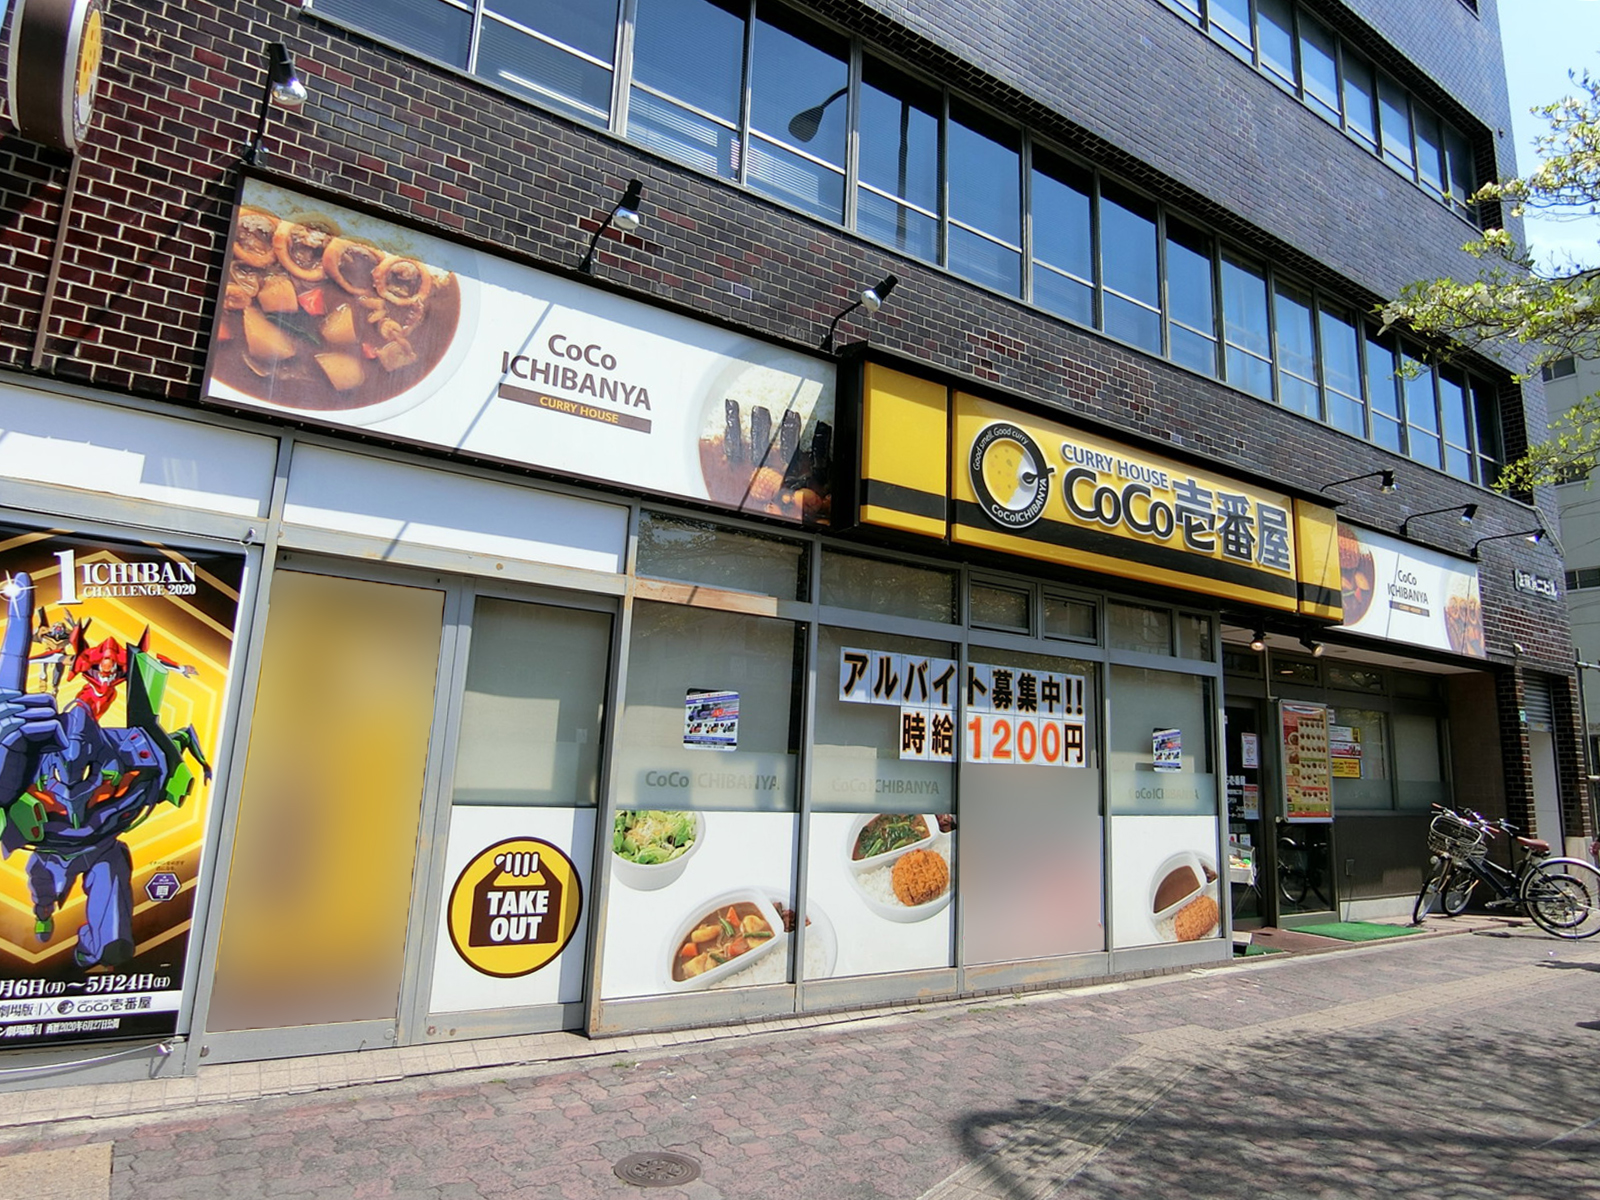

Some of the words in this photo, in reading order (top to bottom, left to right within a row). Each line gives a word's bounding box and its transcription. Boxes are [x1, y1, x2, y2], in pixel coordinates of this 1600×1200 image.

[548, 334, 617, 371] CoCo
[501, 351, 651, 411] ICHIBANYA
[539, 396, 578, 413] CURRY
[579, 405, 619, 424] HOUSE
[993, 427, 1012, 436] Good
[1012, 431, 1028, 445] curry
[1062, 444, 1113, 473] CURRY
[1117, 459, 1169, 490] HOUSE
[53, 549, 83, 605] 1
[82, 561, 197, 586] ICHIBAN
[1398, 569, 1417, 586] CoCo
[83, 584, 165, 599] CHALLENGE
[168, 583, 197, 596] 2020
[1387, 583, 1429, 604] ICHIBANYA
[487, 890, 550, 916] TAKE
[490, 916, 543, 942] OUT
